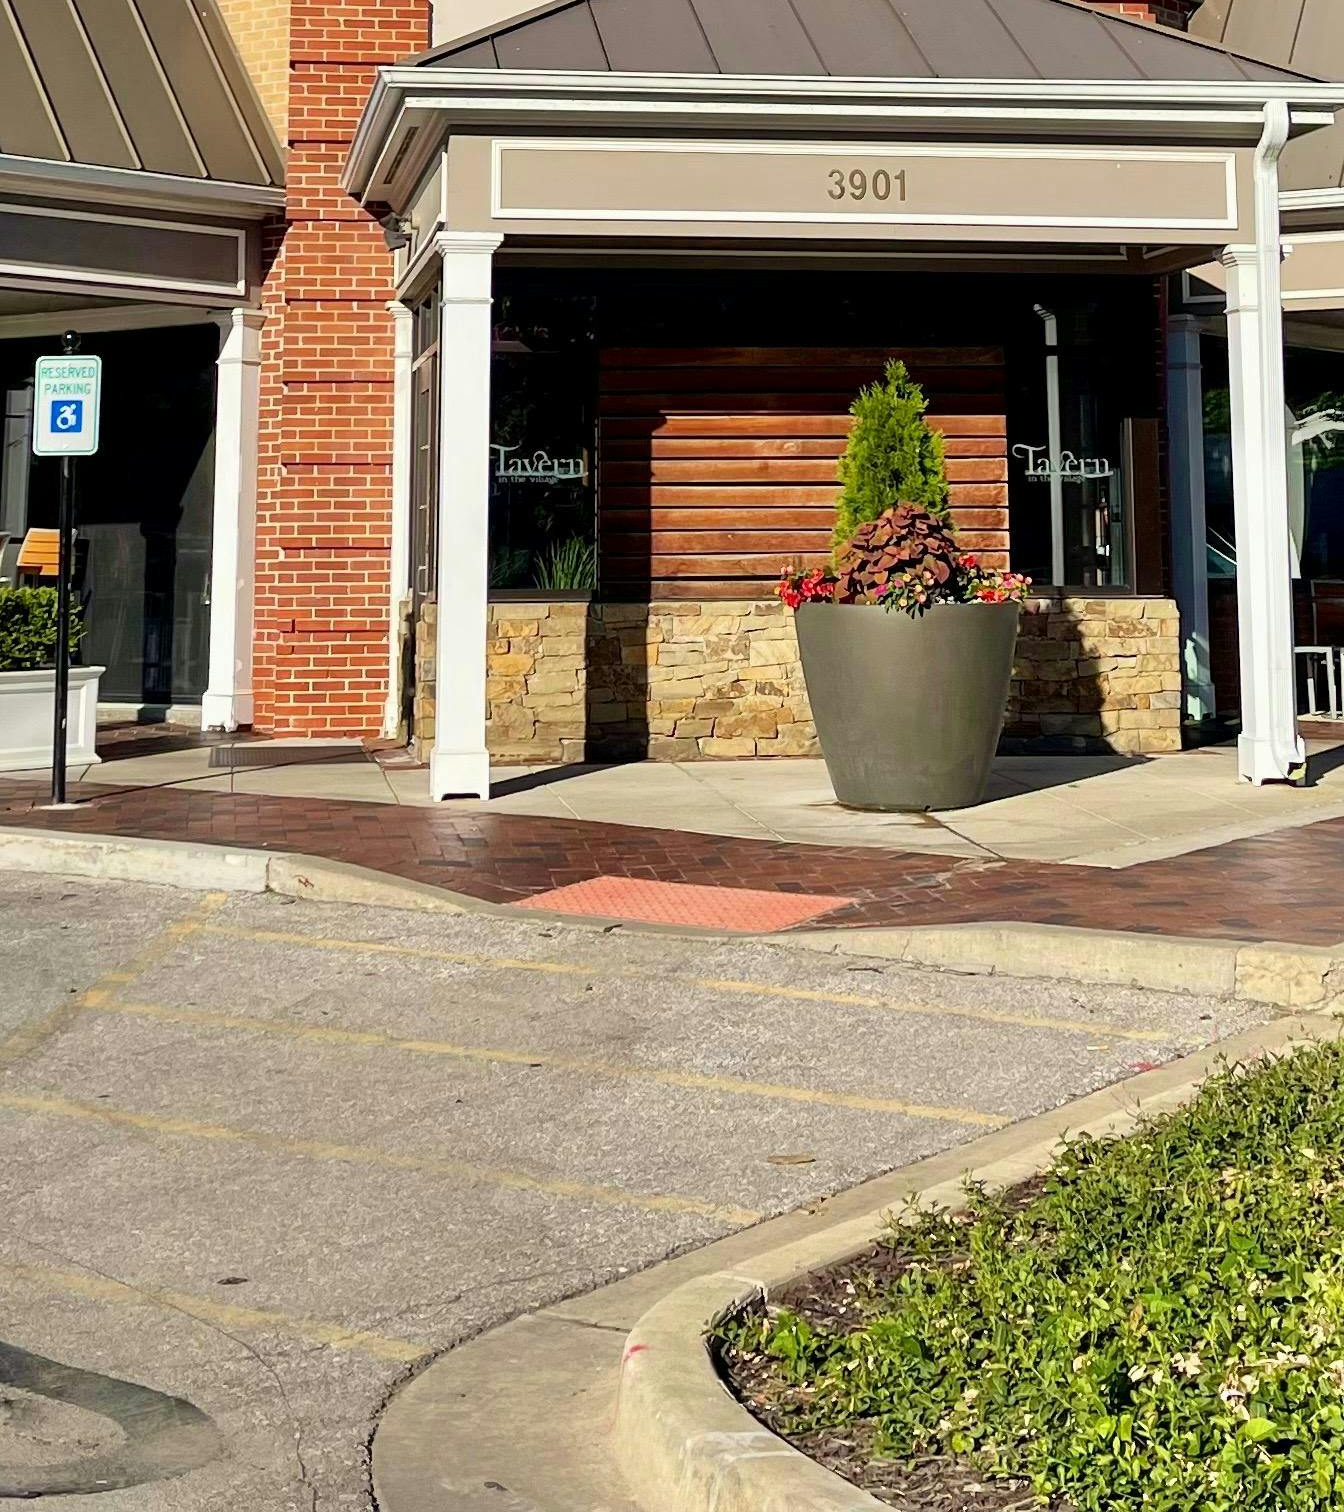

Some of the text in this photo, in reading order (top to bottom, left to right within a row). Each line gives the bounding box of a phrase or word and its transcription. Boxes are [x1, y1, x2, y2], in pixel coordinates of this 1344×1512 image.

[827, 168, 906, 202] 3901
[40, 367, 96, 379] RESERVED
[44, 383, 92, 396] PARKING
[489, 440, 588, 479] Tavern
